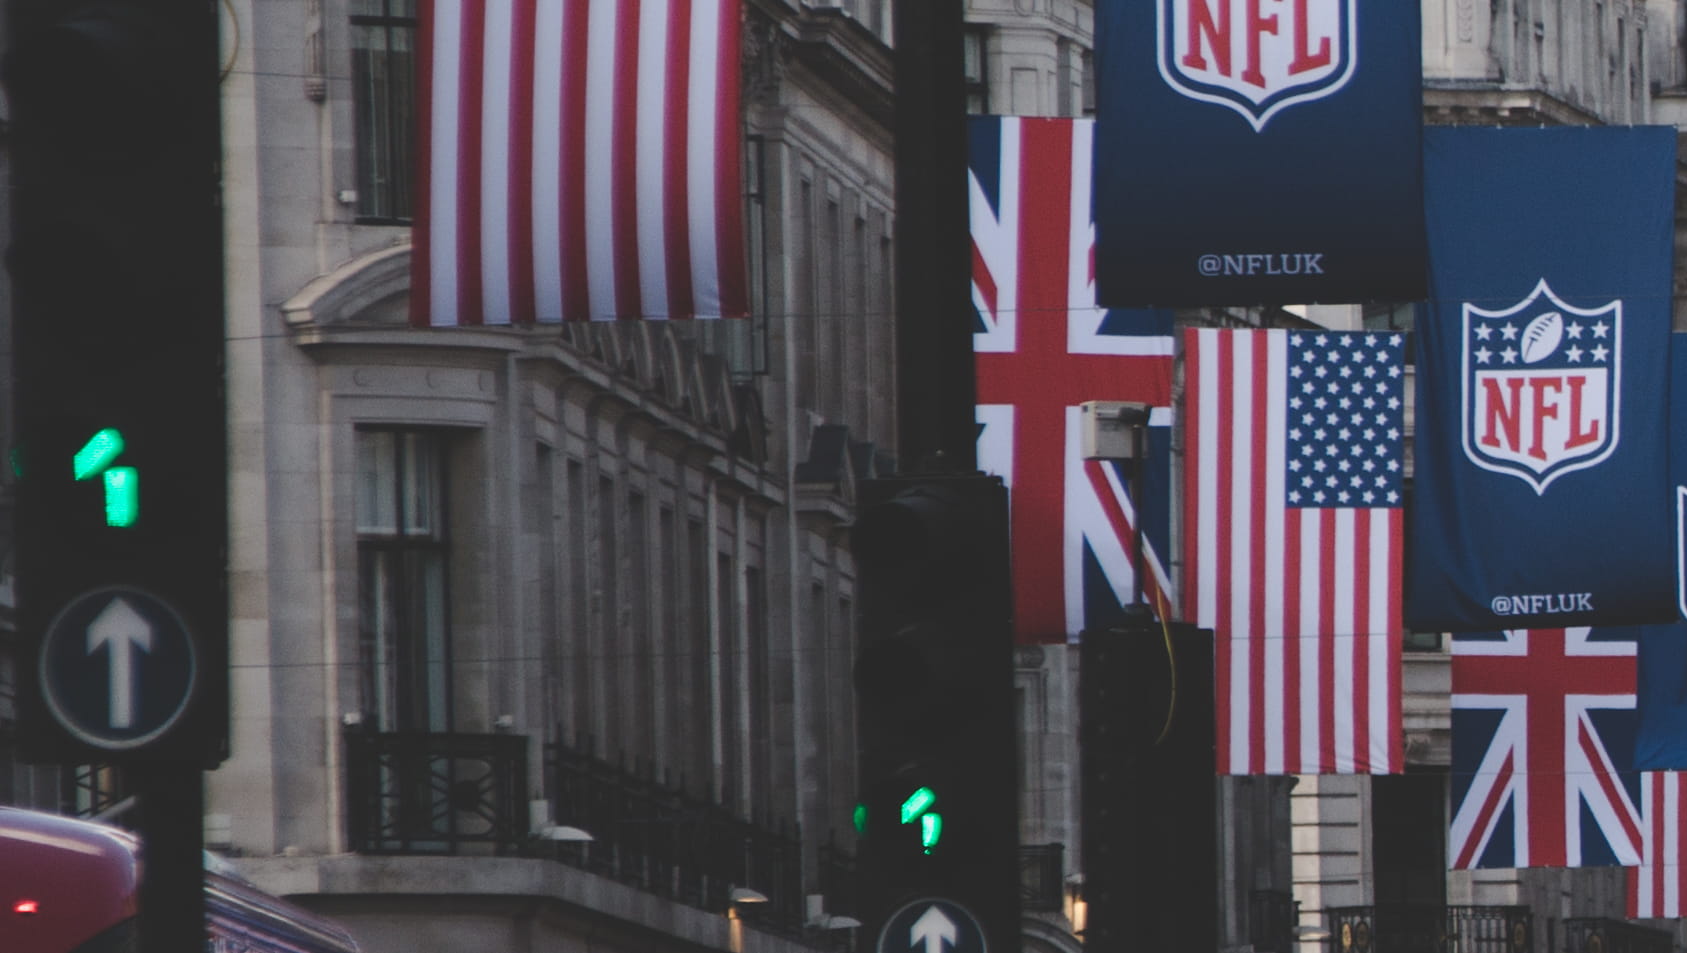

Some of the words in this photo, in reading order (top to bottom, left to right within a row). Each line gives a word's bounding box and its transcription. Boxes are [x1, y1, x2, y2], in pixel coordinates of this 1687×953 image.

[1198, 253, 1325, 277] @NFLUK
[1481, 375, 1599, 462] NFL
[1491, 592, 1595, 616] @NFLUK
